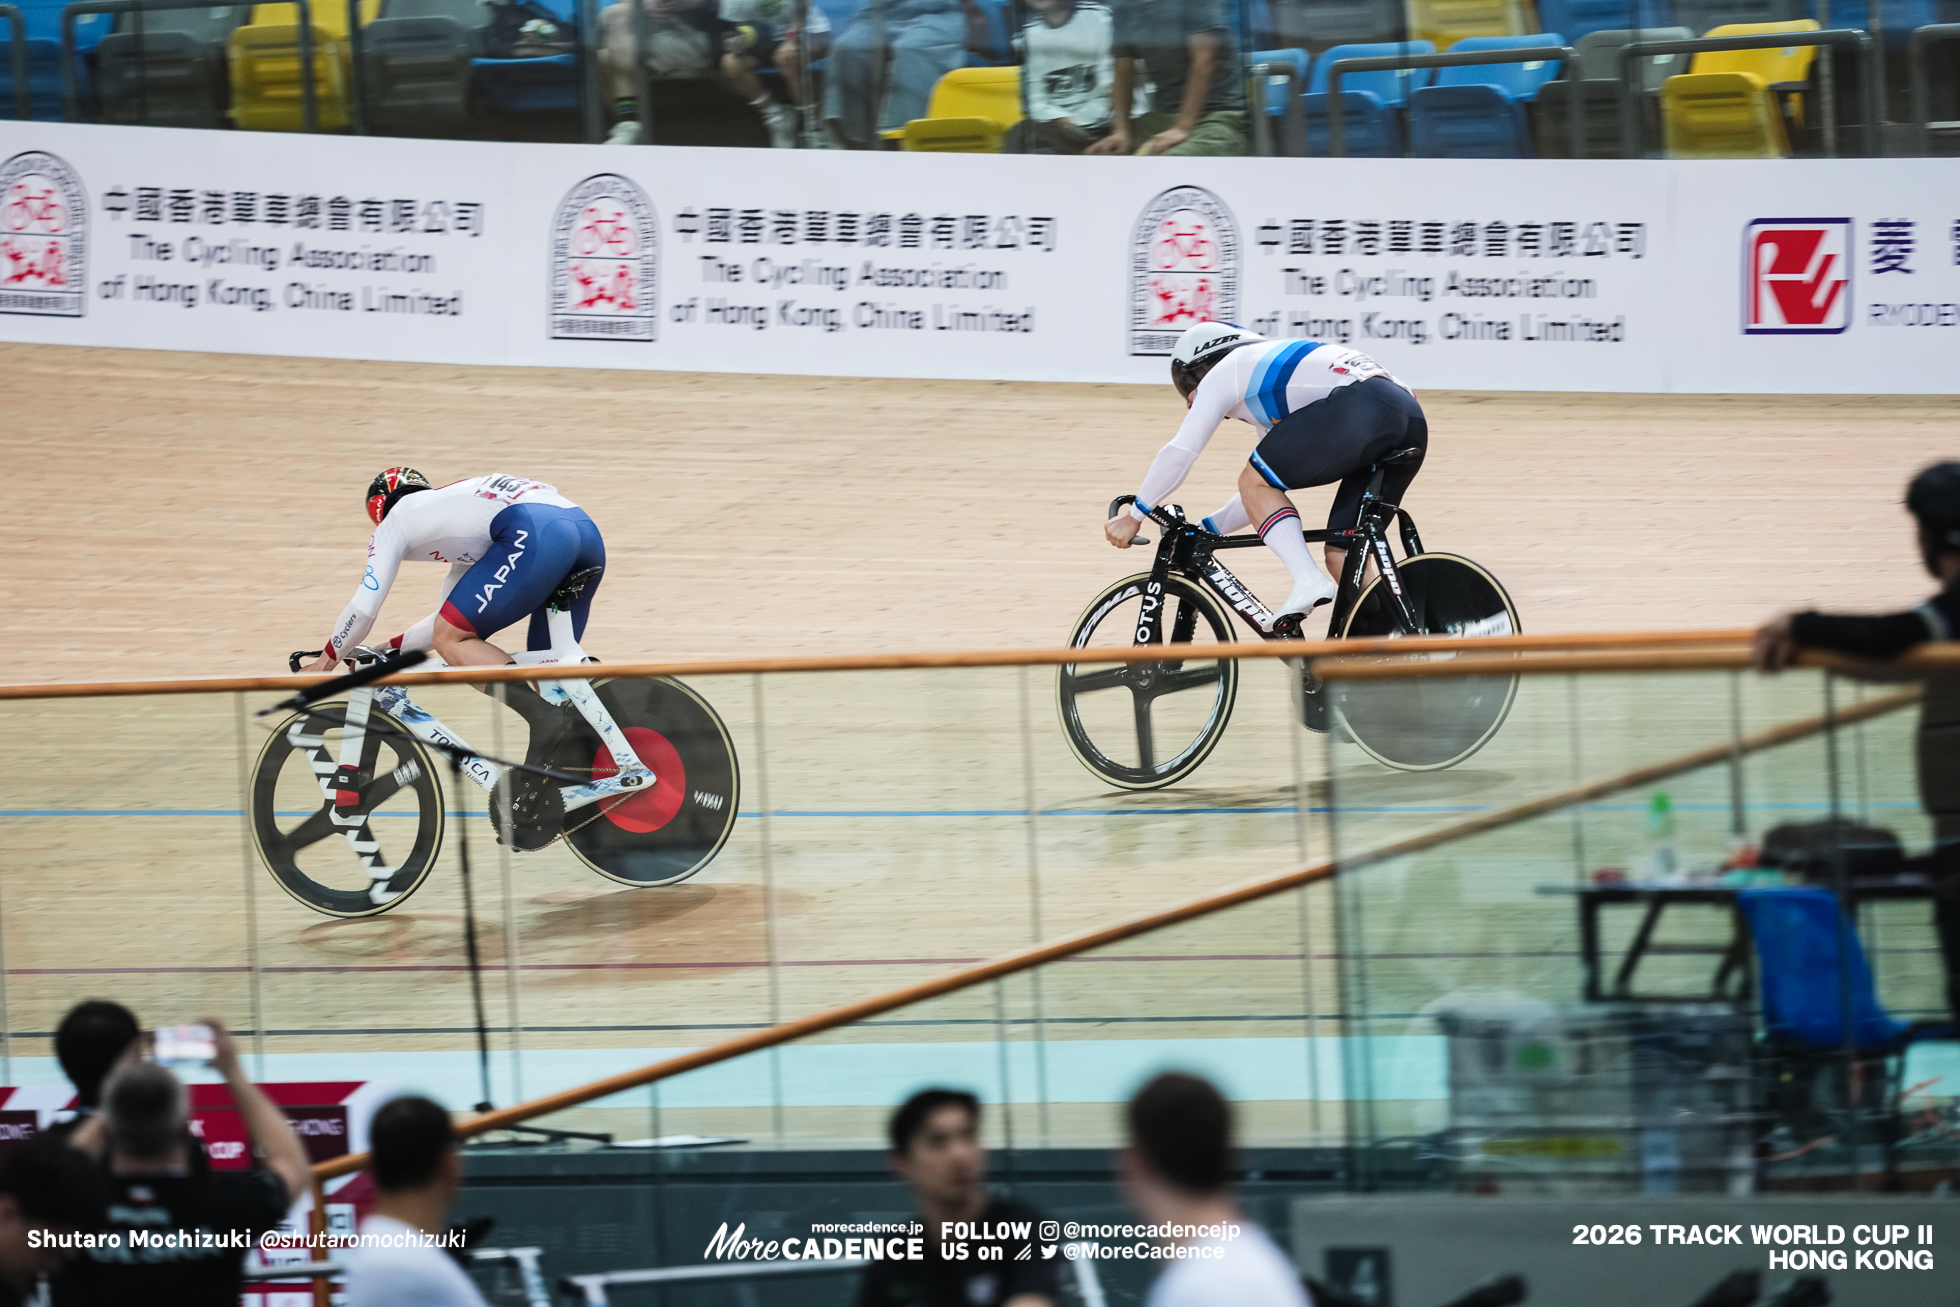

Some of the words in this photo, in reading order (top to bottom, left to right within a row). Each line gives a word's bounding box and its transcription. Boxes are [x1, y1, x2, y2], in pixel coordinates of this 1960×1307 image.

[126, 233, 175, 263] The
[182, 236, 280, 272] Cycling
[287, 241, 436, 274] Association
[1255, 217, 1648, 260] 中國香港單車總會有限公司
[698, 255, 745, 283] The
[752, 257, 850, 291] Cycling
[857, 260, 1008, 291] Association
[1280, 267, 1328, 296] The
[1335, 268, 1436, 302] Cycling
[1442, 270, 1597, 300] Association
[98, 274, 127, 300] of
[133, 275, 199, 309] Hong
[206, 279, 276, 312] Kong,
[284, 282, 355, 312] China
[362, 286, 463, 317] Limited
[670, 297, 699, 323] of
[706, 298, 770, 331] Hong
[777, 300, 846, 333] Kong,
[853, 301, 925, 331] China
[934, 304, 1035, 333] Limited
[1250, 310, 1281, 337] of
[1288, 311, 1353, 343] Hong
[1361, 312, 1433, 344] Kong,
[1439, 312, 1513, 342] China
[1521, 314, 1625, 342] Limited
[1868, 303, 1960, 327] RYODE
[1193, 334, 1241, 356] LAZER
[474, 529, 529, 614] JAPAN
[339, 613, 357, 639] Cyclers
[1134, 582, 1161, 648] OTUS
[430, 728, 490, 781] TOYCA
